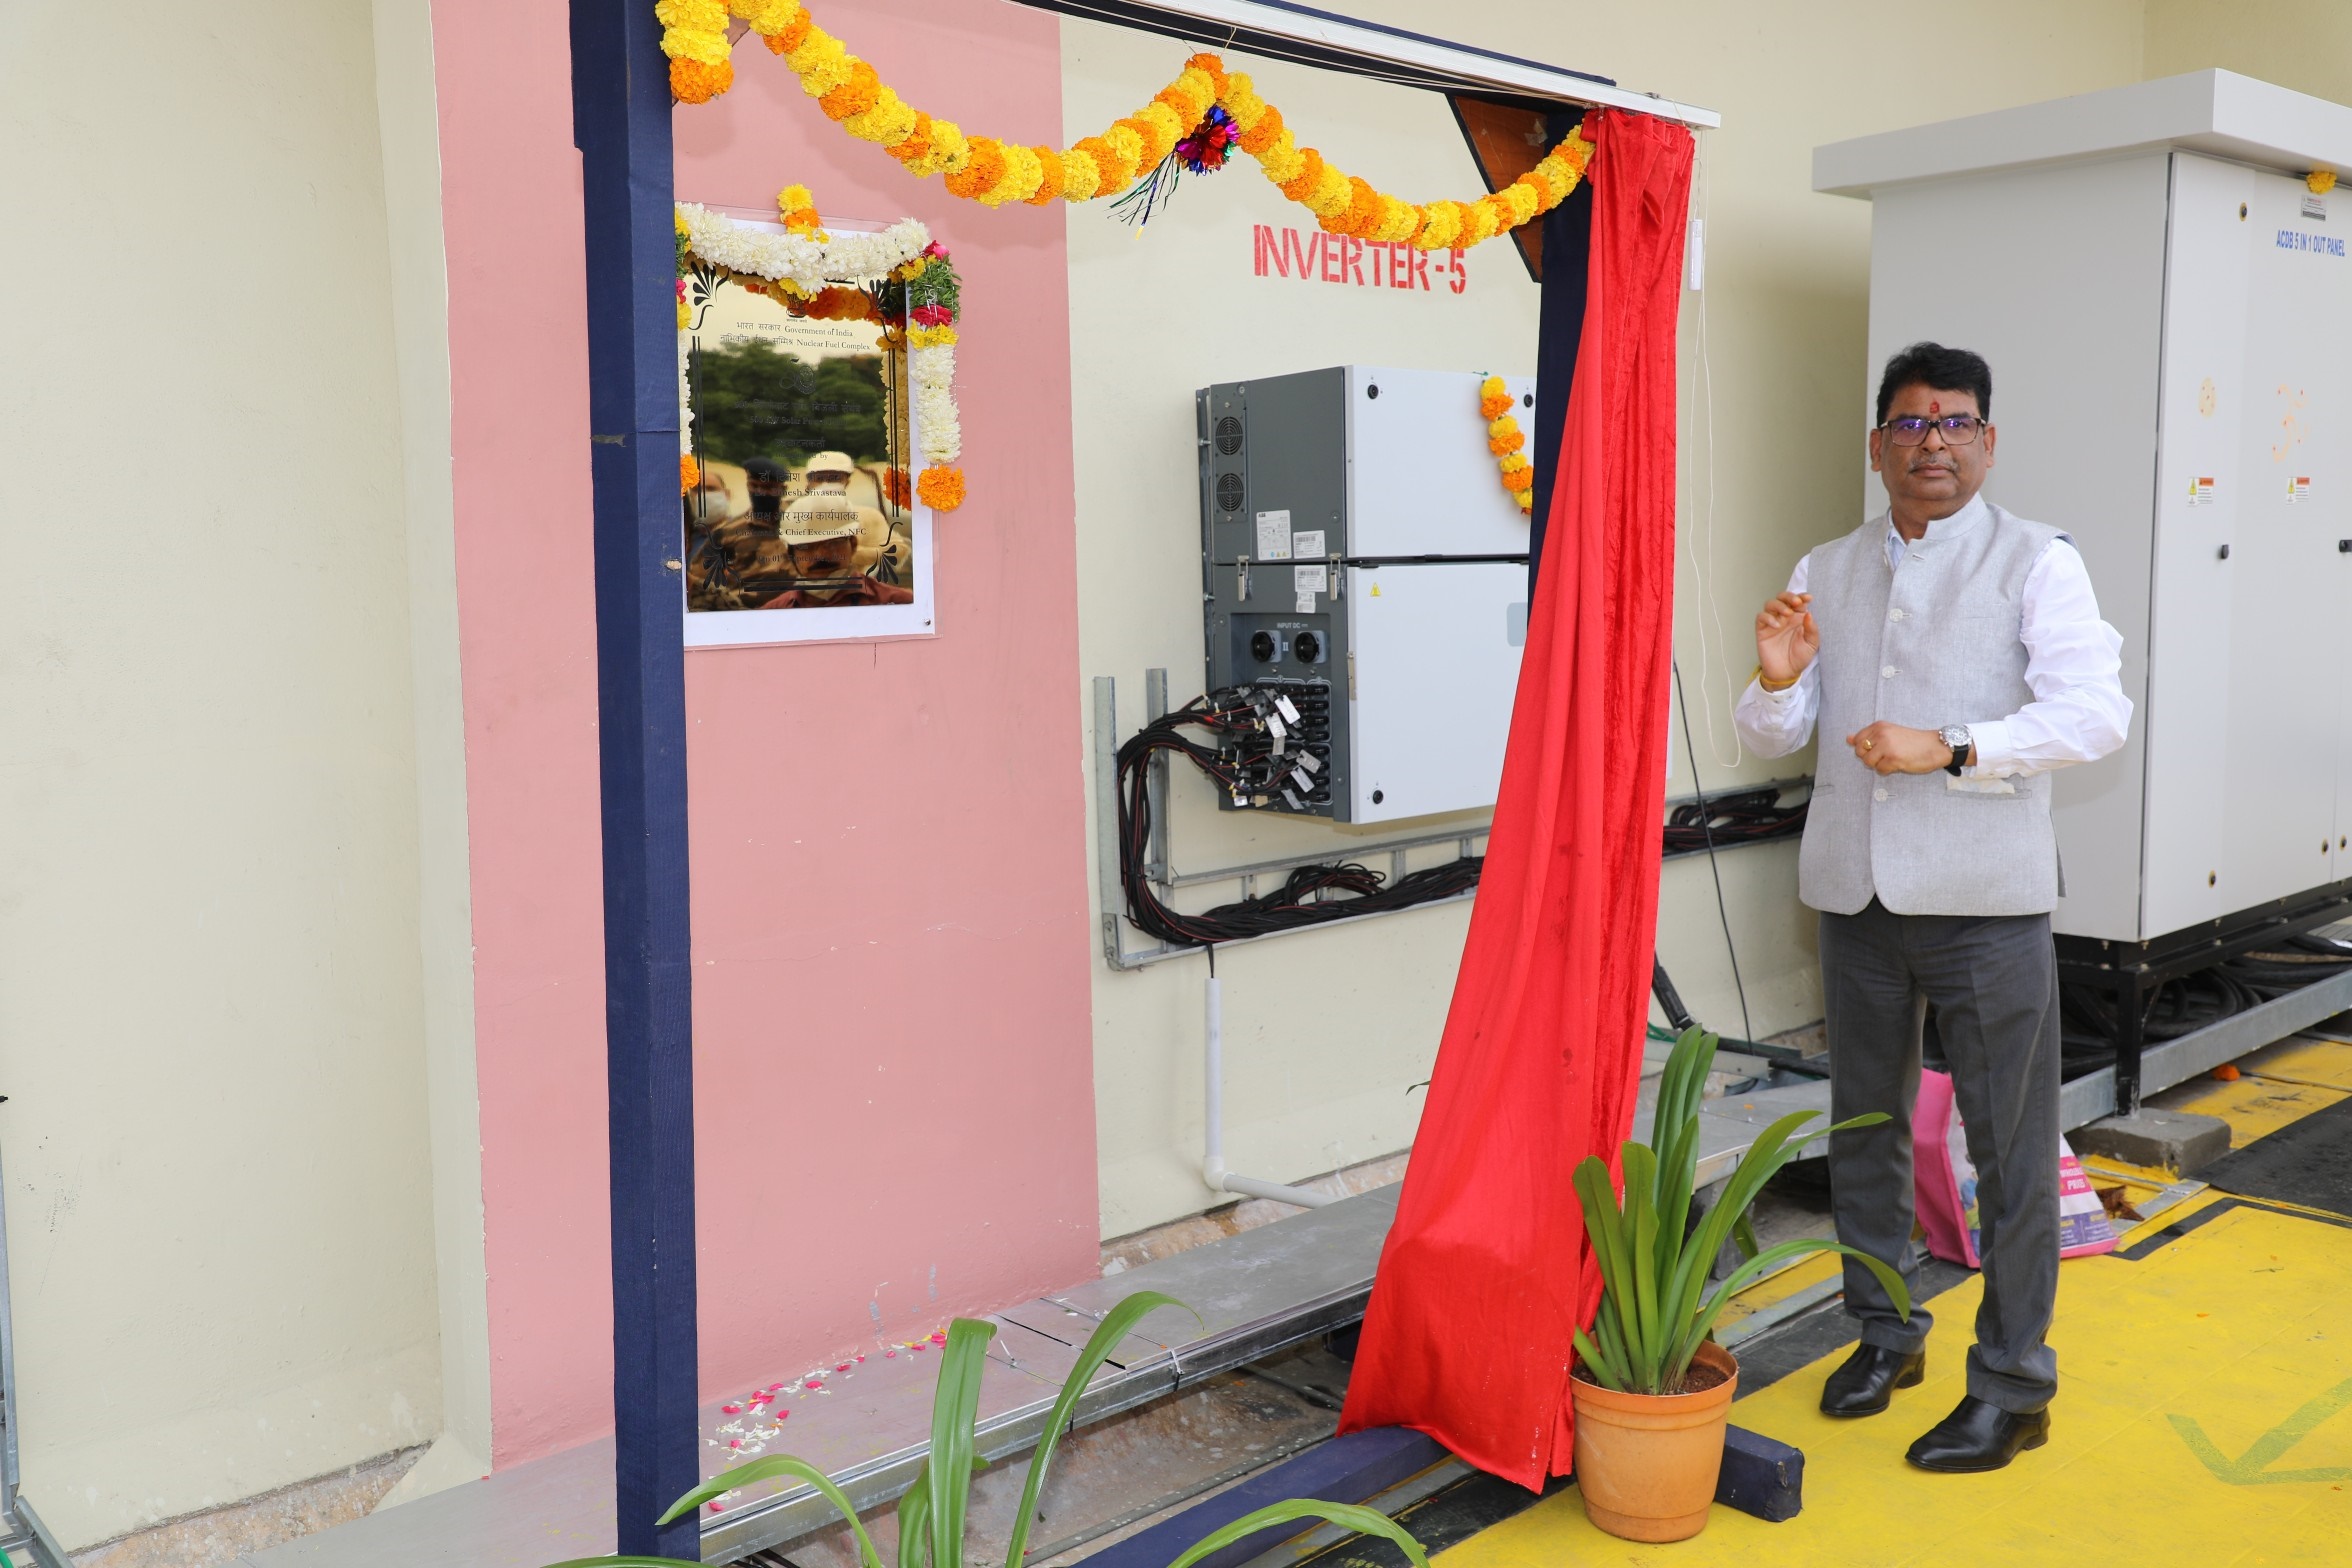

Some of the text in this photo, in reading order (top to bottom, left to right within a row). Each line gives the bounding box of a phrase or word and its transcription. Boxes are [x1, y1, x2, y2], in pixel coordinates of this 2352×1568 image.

[2276, 229, 2345, 257] ACDB 5 IN 1 OUT PANEL
[1253, 224, 1466, 294] INVERTER-5
[737, 321, 854, 337] भारत सरकार Government of India
[797, 338, 824, 348] Nuclear
[825, 340, 840, 349] Fuel
[841, 341, 870, 352] Complex
[804, 488, 847, 497] Srivastava
[793, 511, 814, 523] मुख्य
[816, 508, 859, 521] कार्यपालक
[785, 528, 806, 536] Chief
[807, 529, 847, 537] Executive,
[848, 528, 867, 536] NFC
